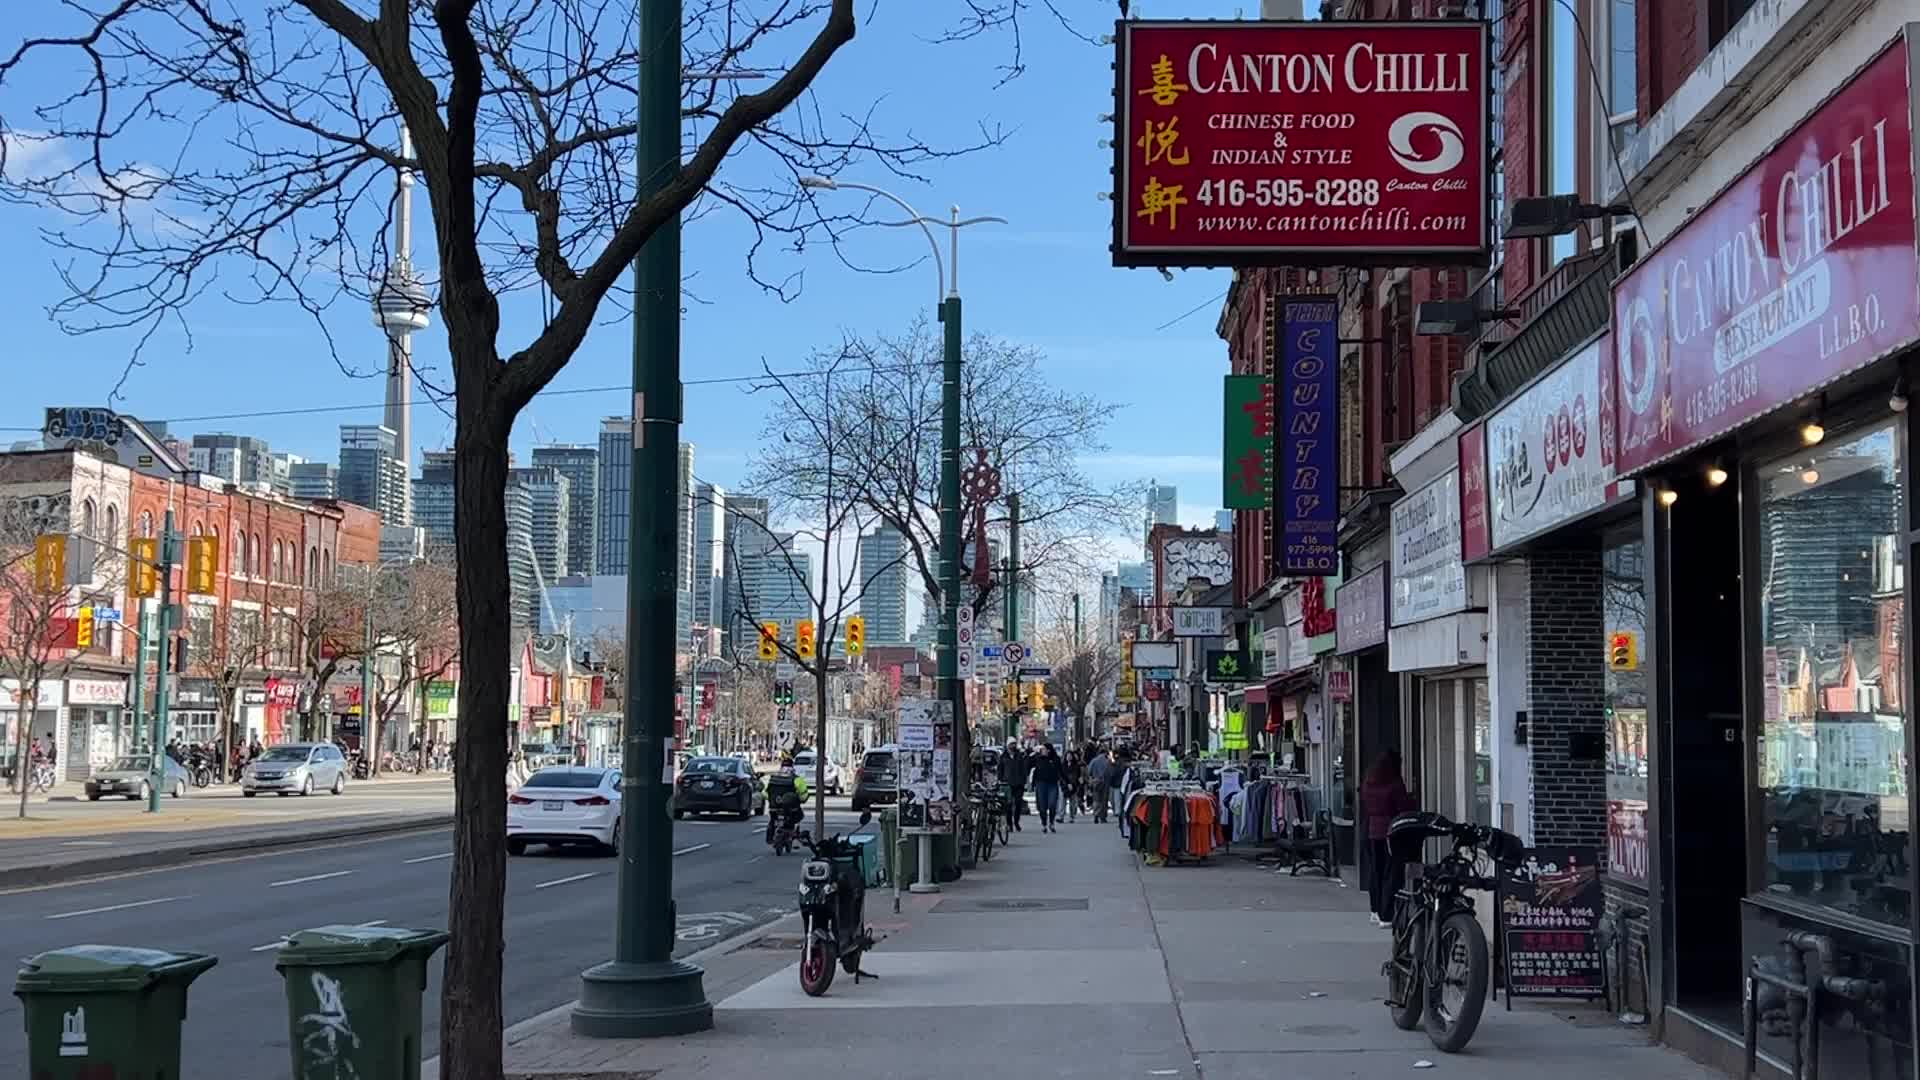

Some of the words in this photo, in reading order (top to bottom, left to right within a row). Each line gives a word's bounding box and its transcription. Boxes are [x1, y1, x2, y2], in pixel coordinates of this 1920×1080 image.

[1188, 43, 1335, 93] CANTON
[1344, 42, 1470, 94] CHILLI
[1208, 113, 1295, 129] CHINESE
[1300, 113, 1356, 129] FOOD
[1274, 132, 1288, 148] &
[1211, 150, 1285, 165] INDIAN
[1291, 150, 1353, 165] STYLE
[1197, 178, 1380, 207] 416-595-8288
[1386, 178, 1429, 192] Canton
[1431, 177, 1468, 192] Chilli
[1198, 207, 1467, 232] www.cantonchilli.com
[1671, 212, 1770, 345] CANTON
[1776, 118, 1891, 275] CHILLI
[1285, 303, 1335, 322] THAI
[1723, 273, 1817, 361] RESTAURANT
[1819, 294, 1885, 360] L.L.B.O.
[1290, 329, 1324, 519] COUNTRY
[1302, 535, 1318, 545] 416
[1287, 557, 1334, 569] L.L.B.O.
[1328, 672, 1350, 689] ATM
[1608, 835, 1625, 874] ALL
[1625, 837, 1646, 879] YOU
